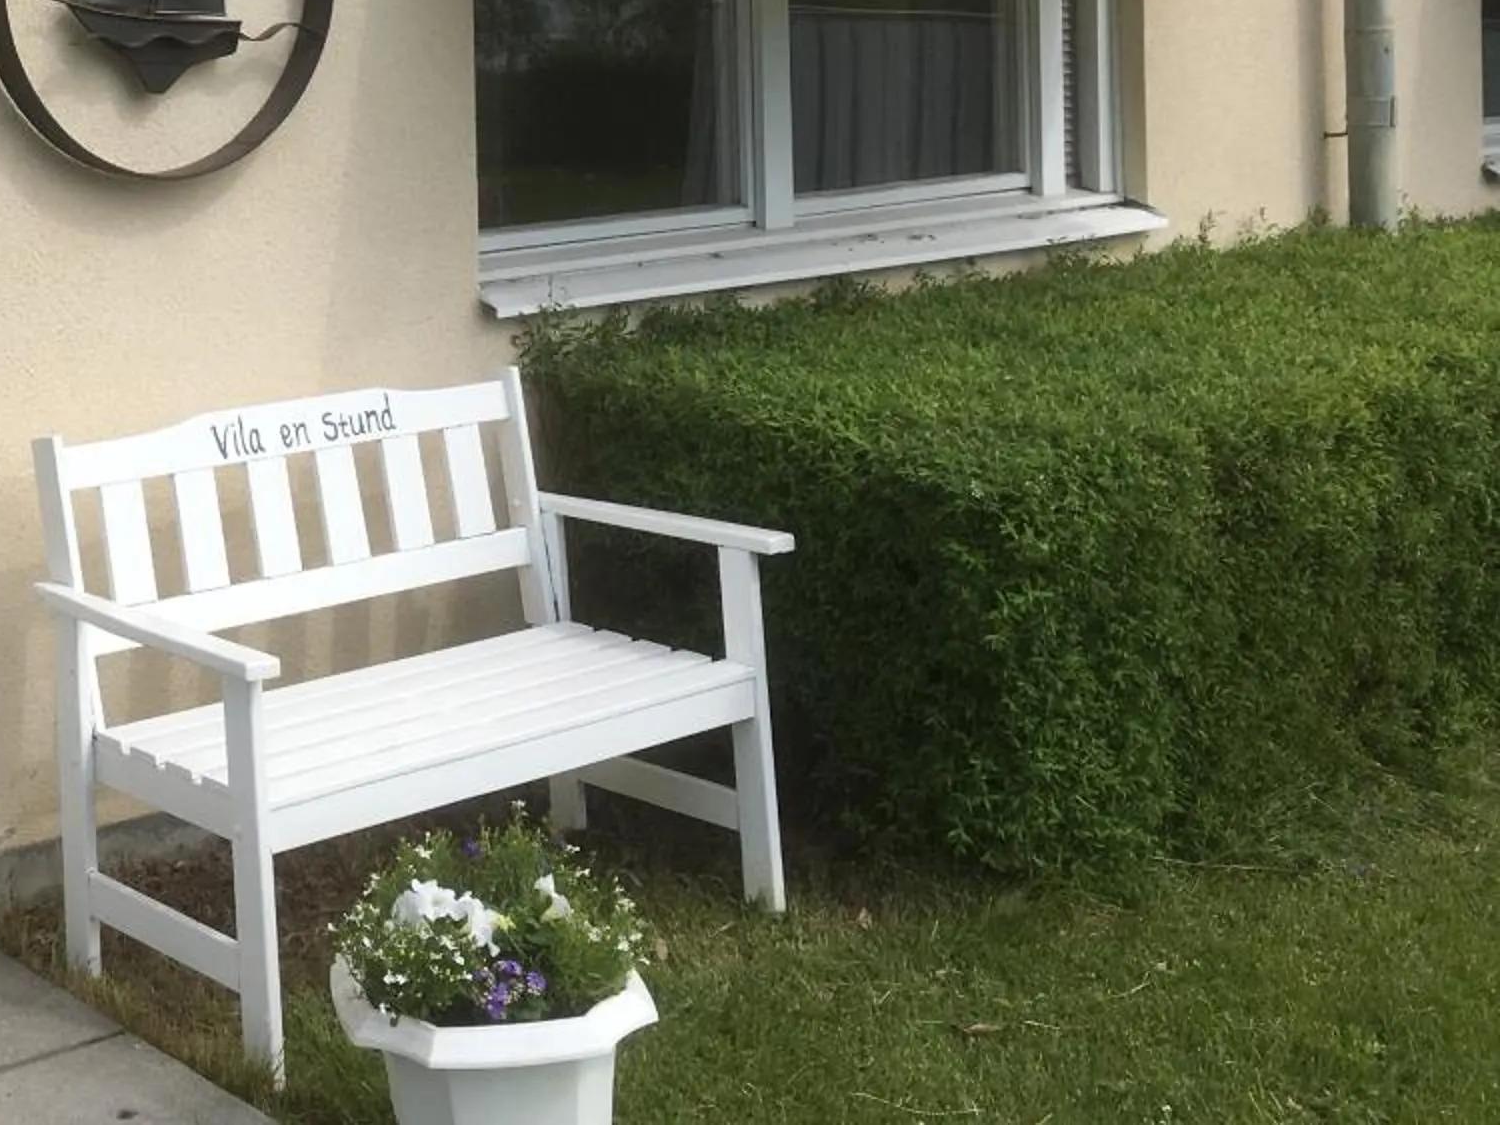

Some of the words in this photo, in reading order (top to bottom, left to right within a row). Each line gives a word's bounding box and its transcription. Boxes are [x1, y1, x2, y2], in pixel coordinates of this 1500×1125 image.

[210, 415, 266, 459] Vila
[279, 421, 311, 448] en
[321, 392, 397, 441] Stund
